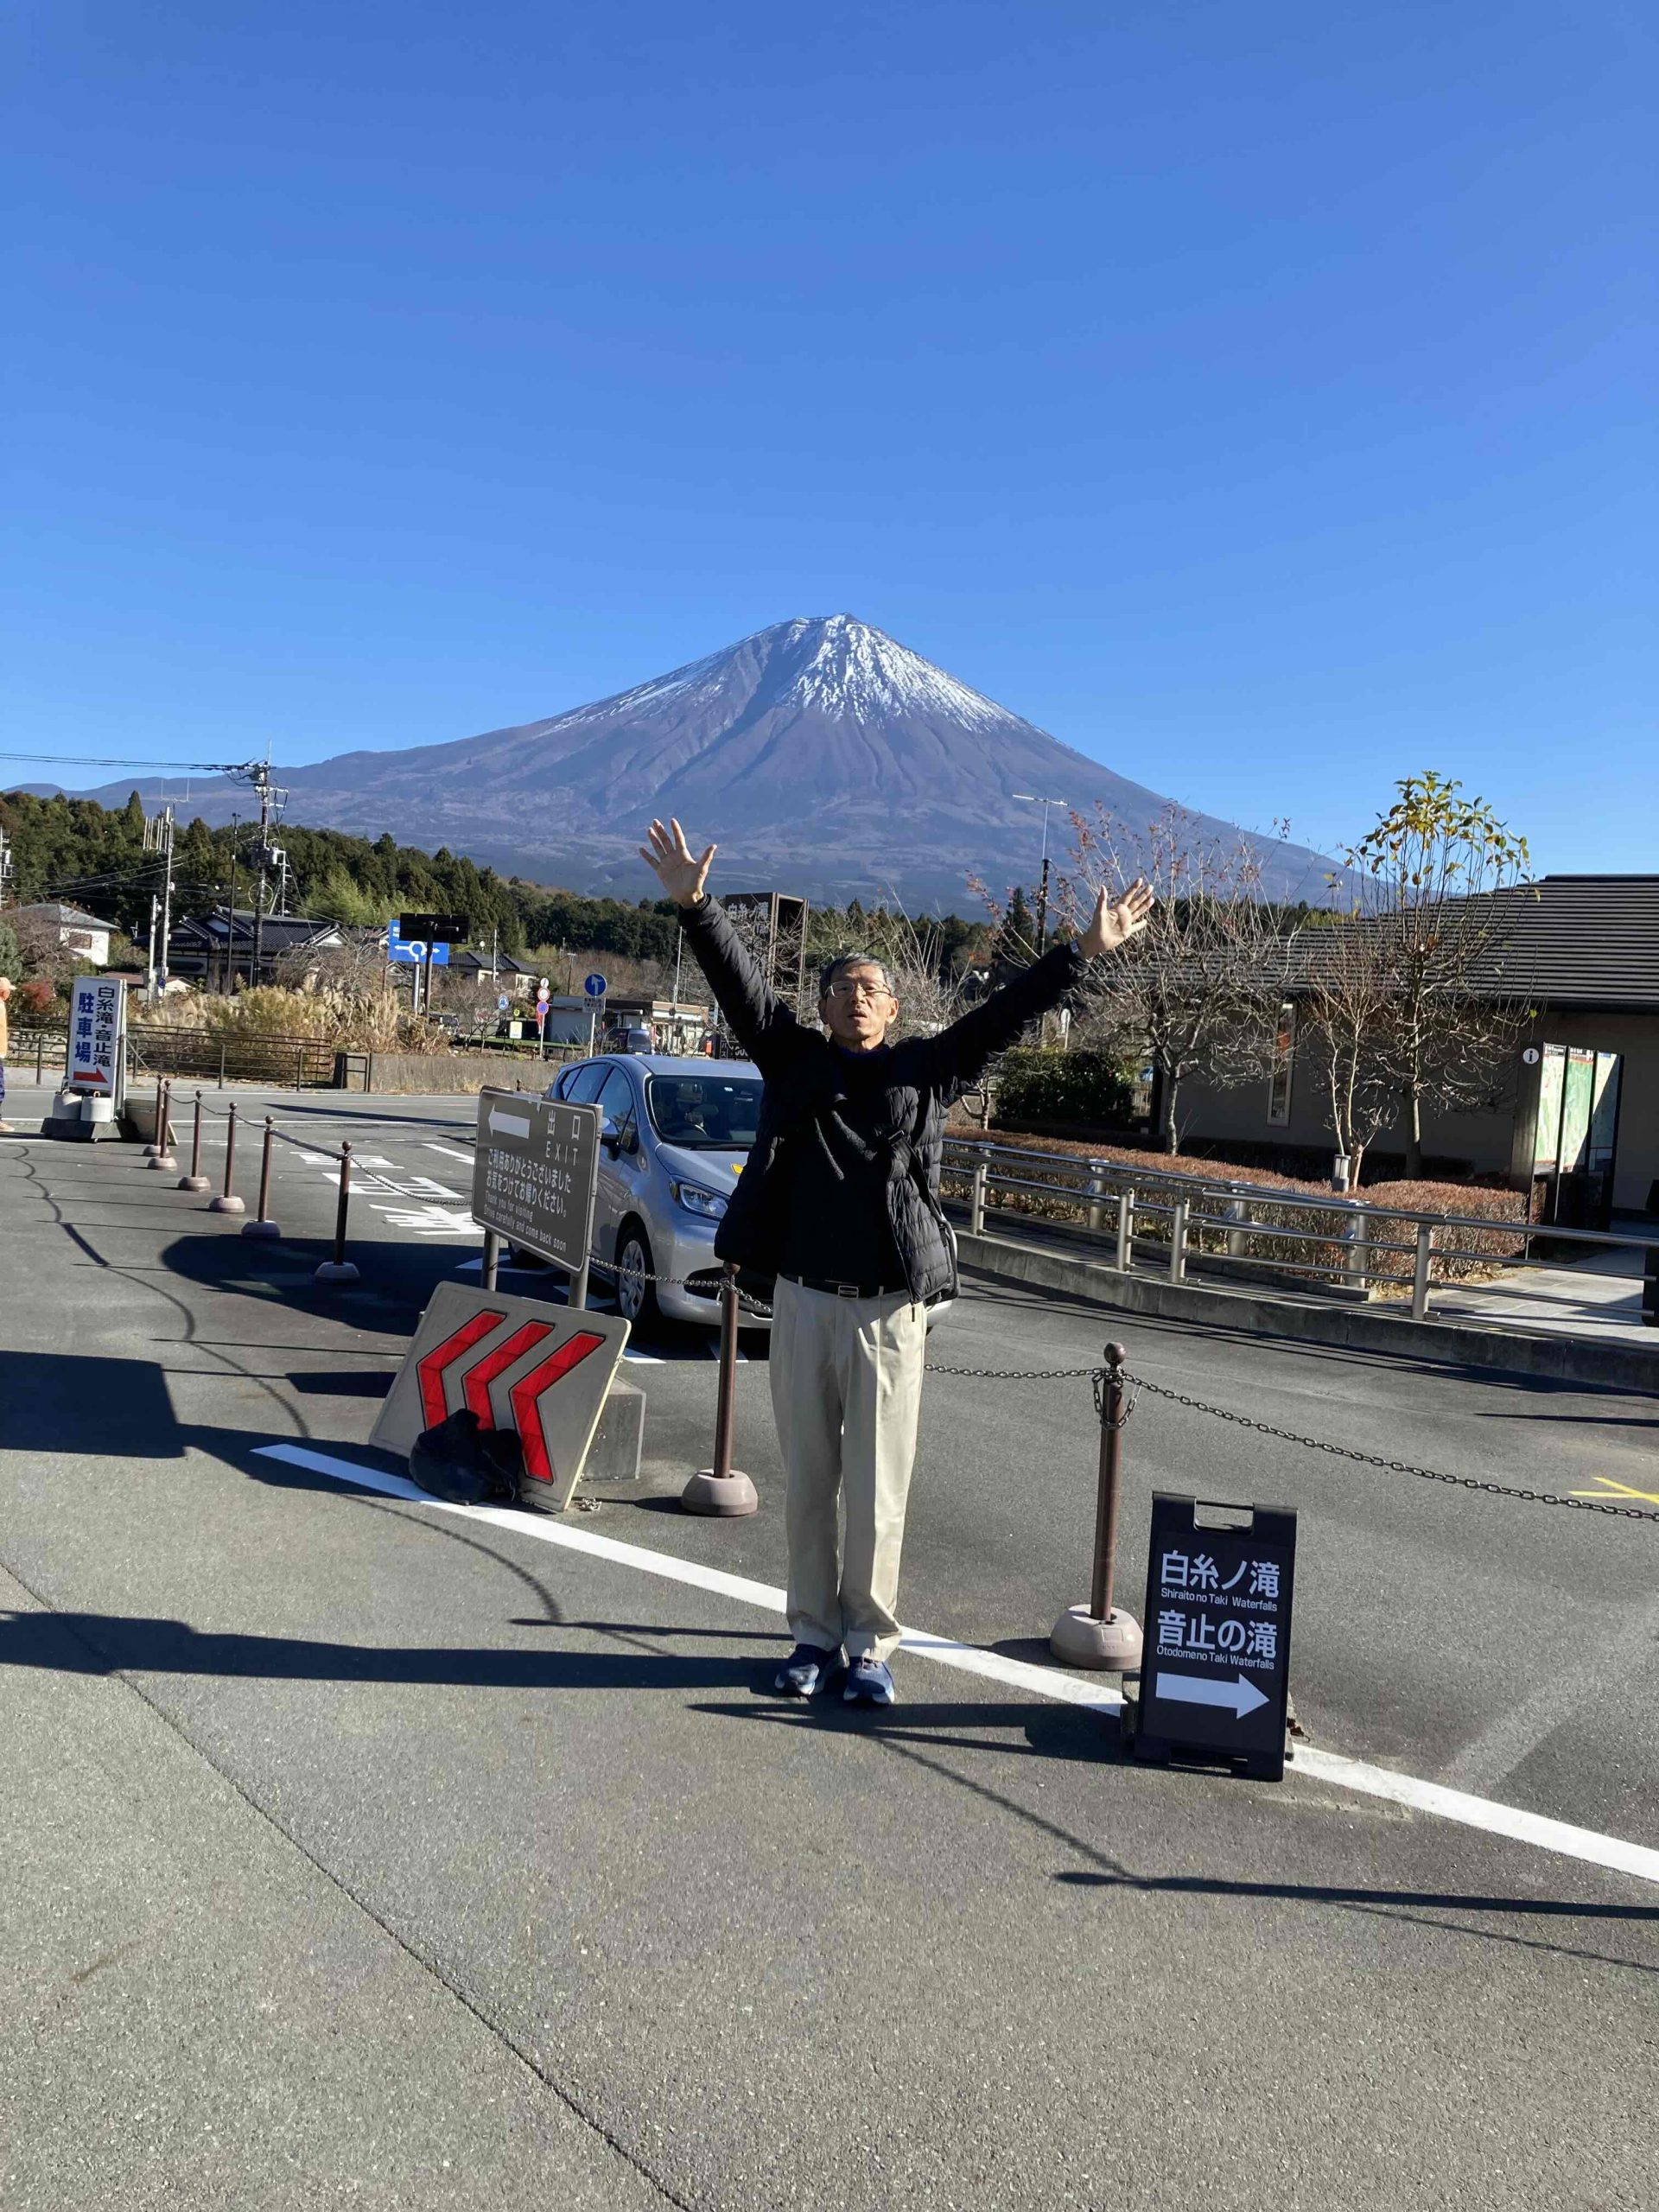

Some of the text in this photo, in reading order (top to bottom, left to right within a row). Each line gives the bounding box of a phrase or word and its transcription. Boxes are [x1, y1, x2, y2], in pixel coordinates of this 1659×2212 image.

[74, 992, 95, 1064] 駐車場
[92, 986, 115, 1068] 白糸滝・音止滝
[547, 1109, 581, 1141] 出口
[487, 1147, 571, 1193] ご利用ありがとうございました
[545, 1141, 578, 1166] EXIT
[539, 1229, 552, 1244] back
[553, 1237, 567, 1252] soon
[1161, 1549, 1280, 1599] 白糸ノ滝
[1160, 1587, 1278, 1612] Shiraito no Taki Waterfalls
[1157, 1609, 1278, 1659] 音止の滝
[1209, 1651, 1228, 1664] Taki
[1230, 1655, 1274, 1670] Waterfalls
